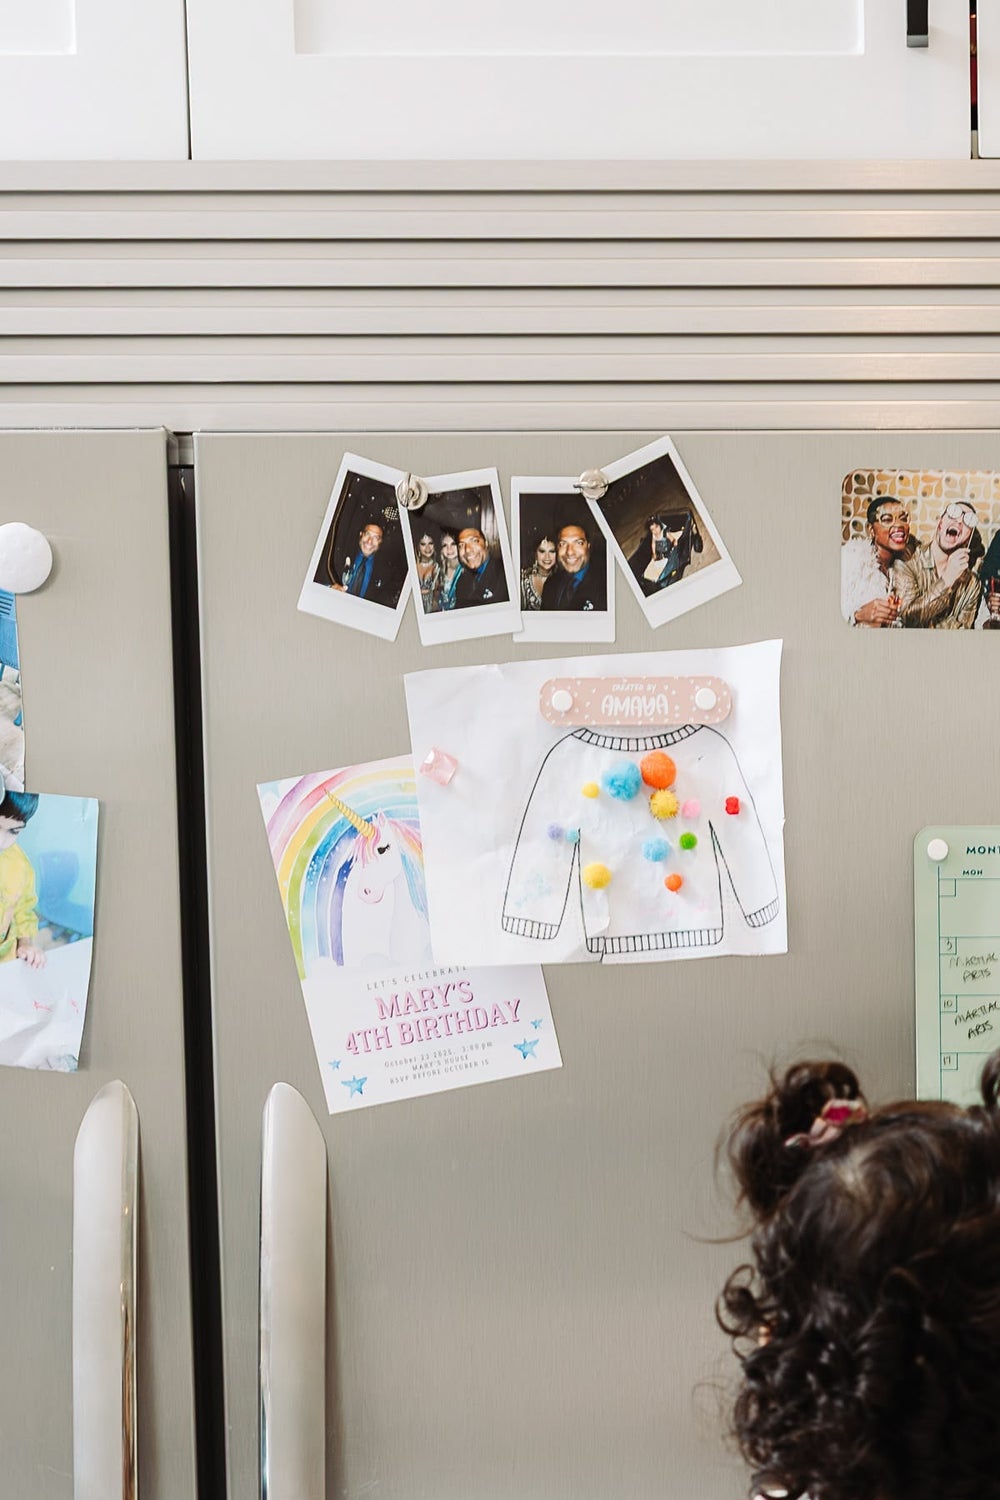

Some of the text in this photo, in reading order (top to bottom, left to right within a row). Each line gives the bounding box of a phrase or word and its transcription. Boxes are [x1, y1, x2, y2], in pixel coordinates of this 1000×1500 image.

[601, 693, 669, 719] AMAYA
[375, 979, 474, 1020] MARY'S
[943, 1000, 953, 1008] 10
[346, 998, 522, 1055] 4TH BIRTHDAY
[967, 1020, 994, 1039] ARTS
